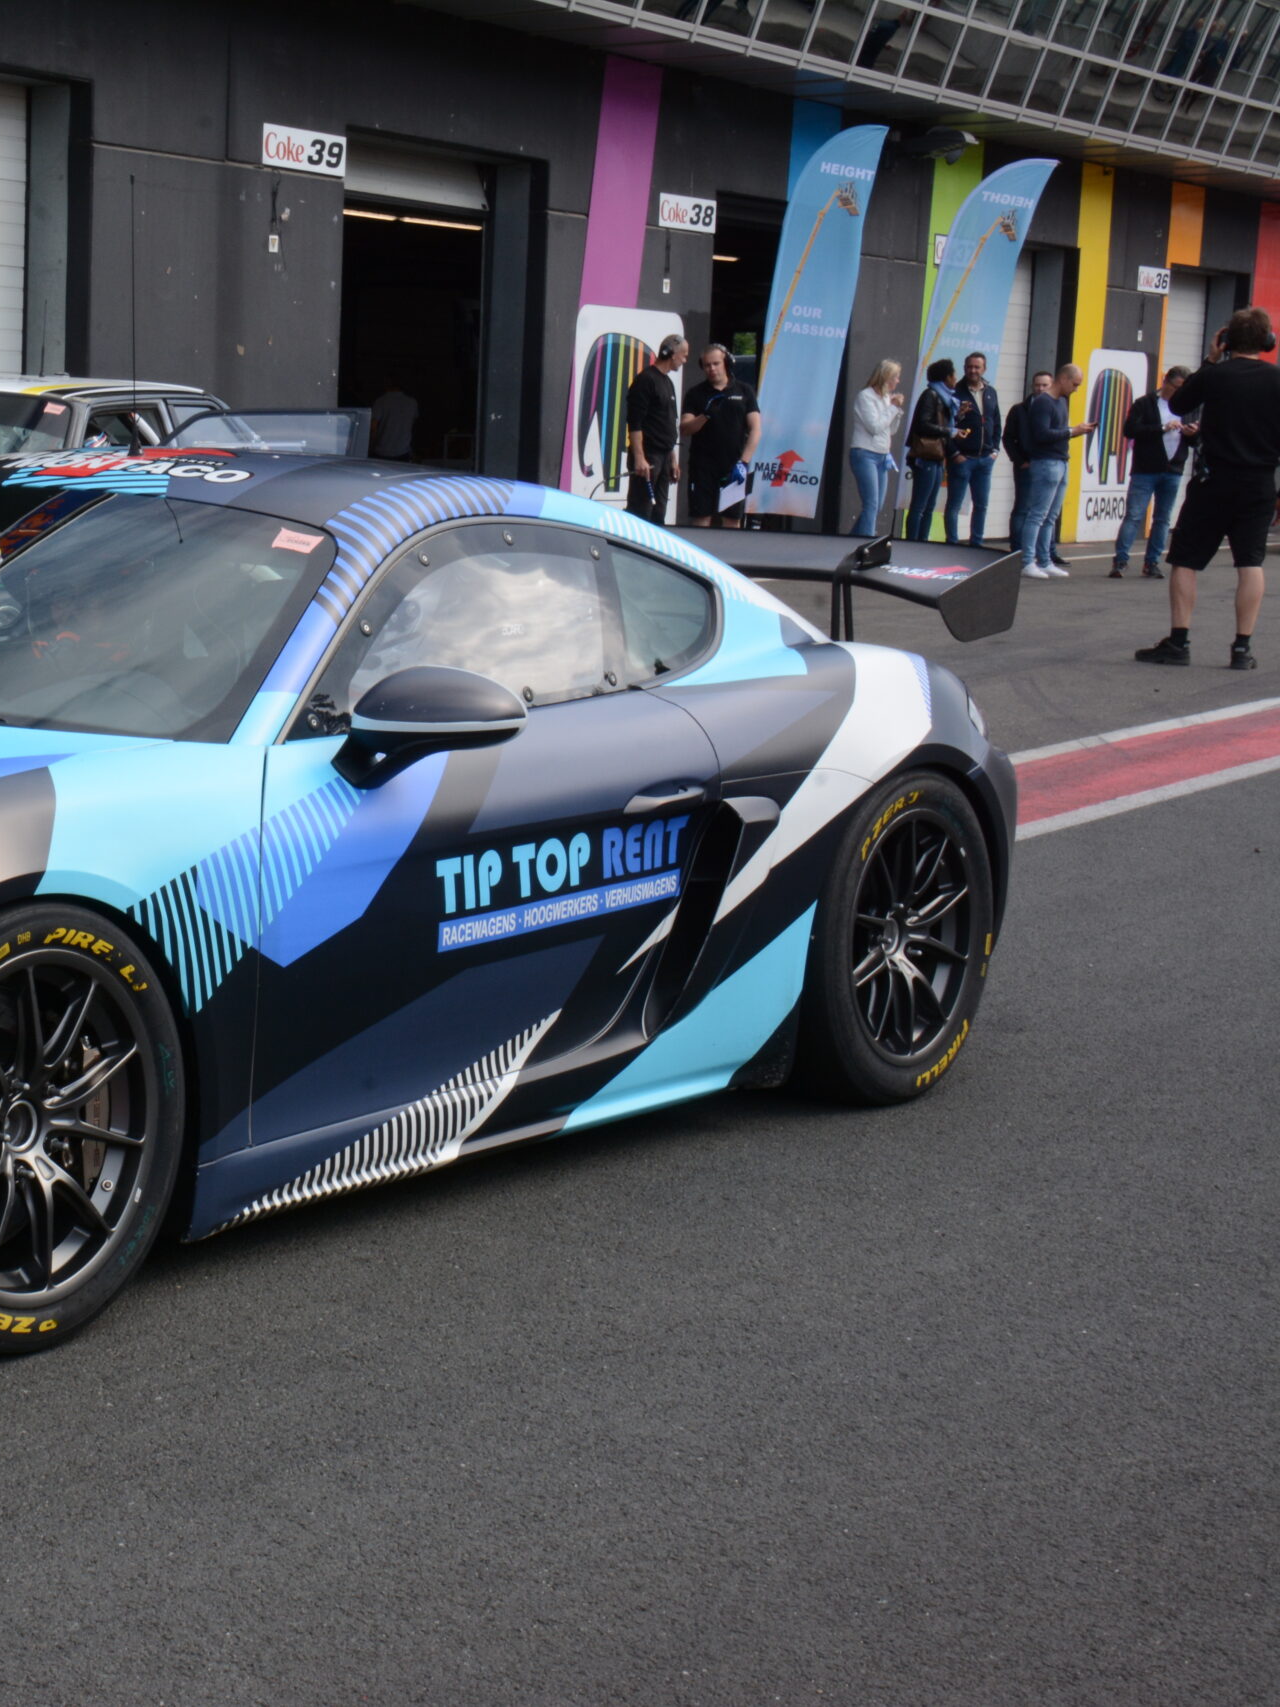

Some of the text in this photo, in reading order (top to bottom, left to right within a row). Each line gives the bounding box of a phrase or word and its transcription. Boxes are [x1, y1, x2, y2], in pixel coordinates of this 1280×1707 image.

[264, 131, 344, 168] Coke 39
[820, 161, 876, 182] HEIGHT
[661, 199, 715, 227] Coke 38
[1154, 272, 1169, 289] 36
[792, 305, 823, 319] OUR
[783, 322, 847, 339] PASSION
[1, 454, 252, 483] MONTACO
[1086, 496, 1125, 521] CAPARO
[435, 813, 692, 915] TIP TOP RENT
[442, 874, 678, 947] RACEWAGENS HOOGWERKERS VERHUISWAGENS
[43, 927, 149, 992] PIRELI
[916, 1018, 970, 1088] PIRELLI
